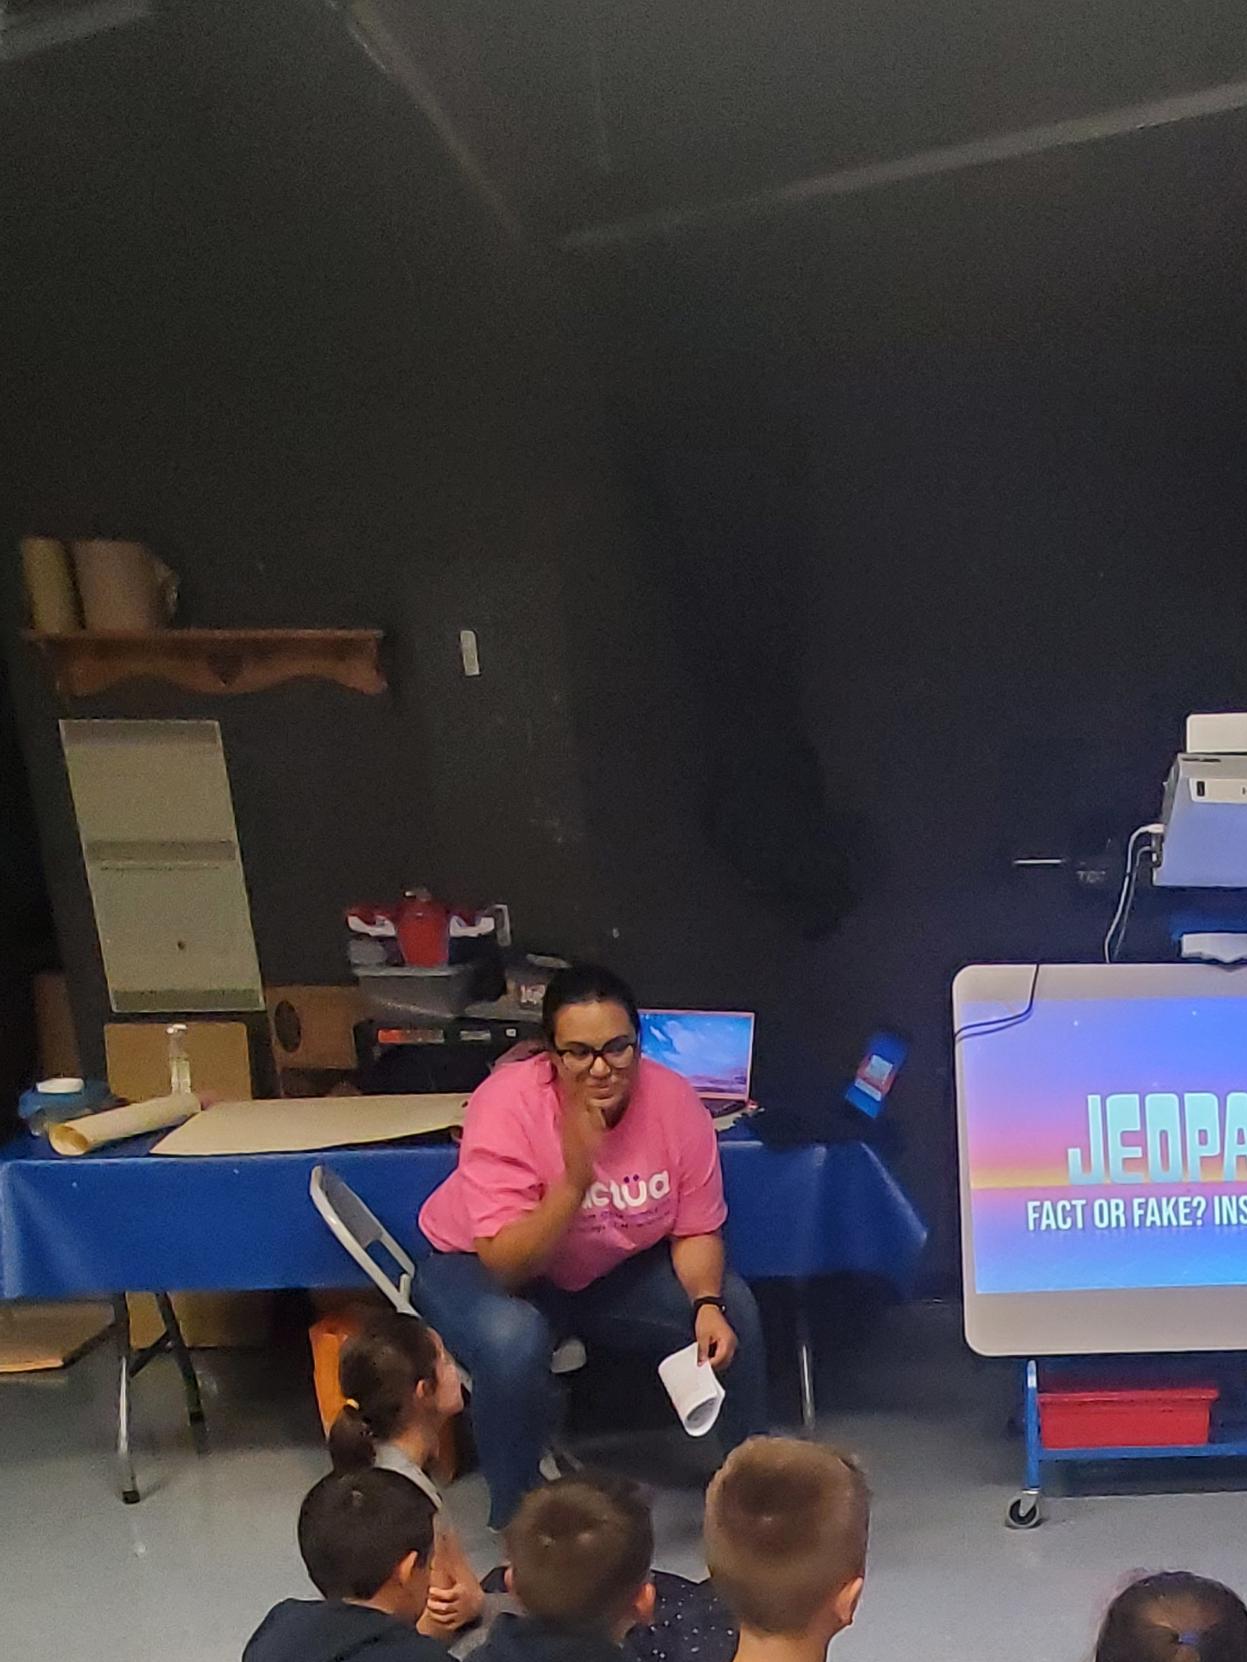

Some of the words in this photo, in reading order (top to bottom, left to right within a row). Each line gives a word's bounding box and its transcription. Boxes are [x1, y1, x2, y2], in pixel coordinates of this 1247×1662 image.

[1026, 1199, 1087, 1231] FACT
[1093, 1198, 1126, 1229] OR
[1132, 1196, 1207, 1228] FAKE?
